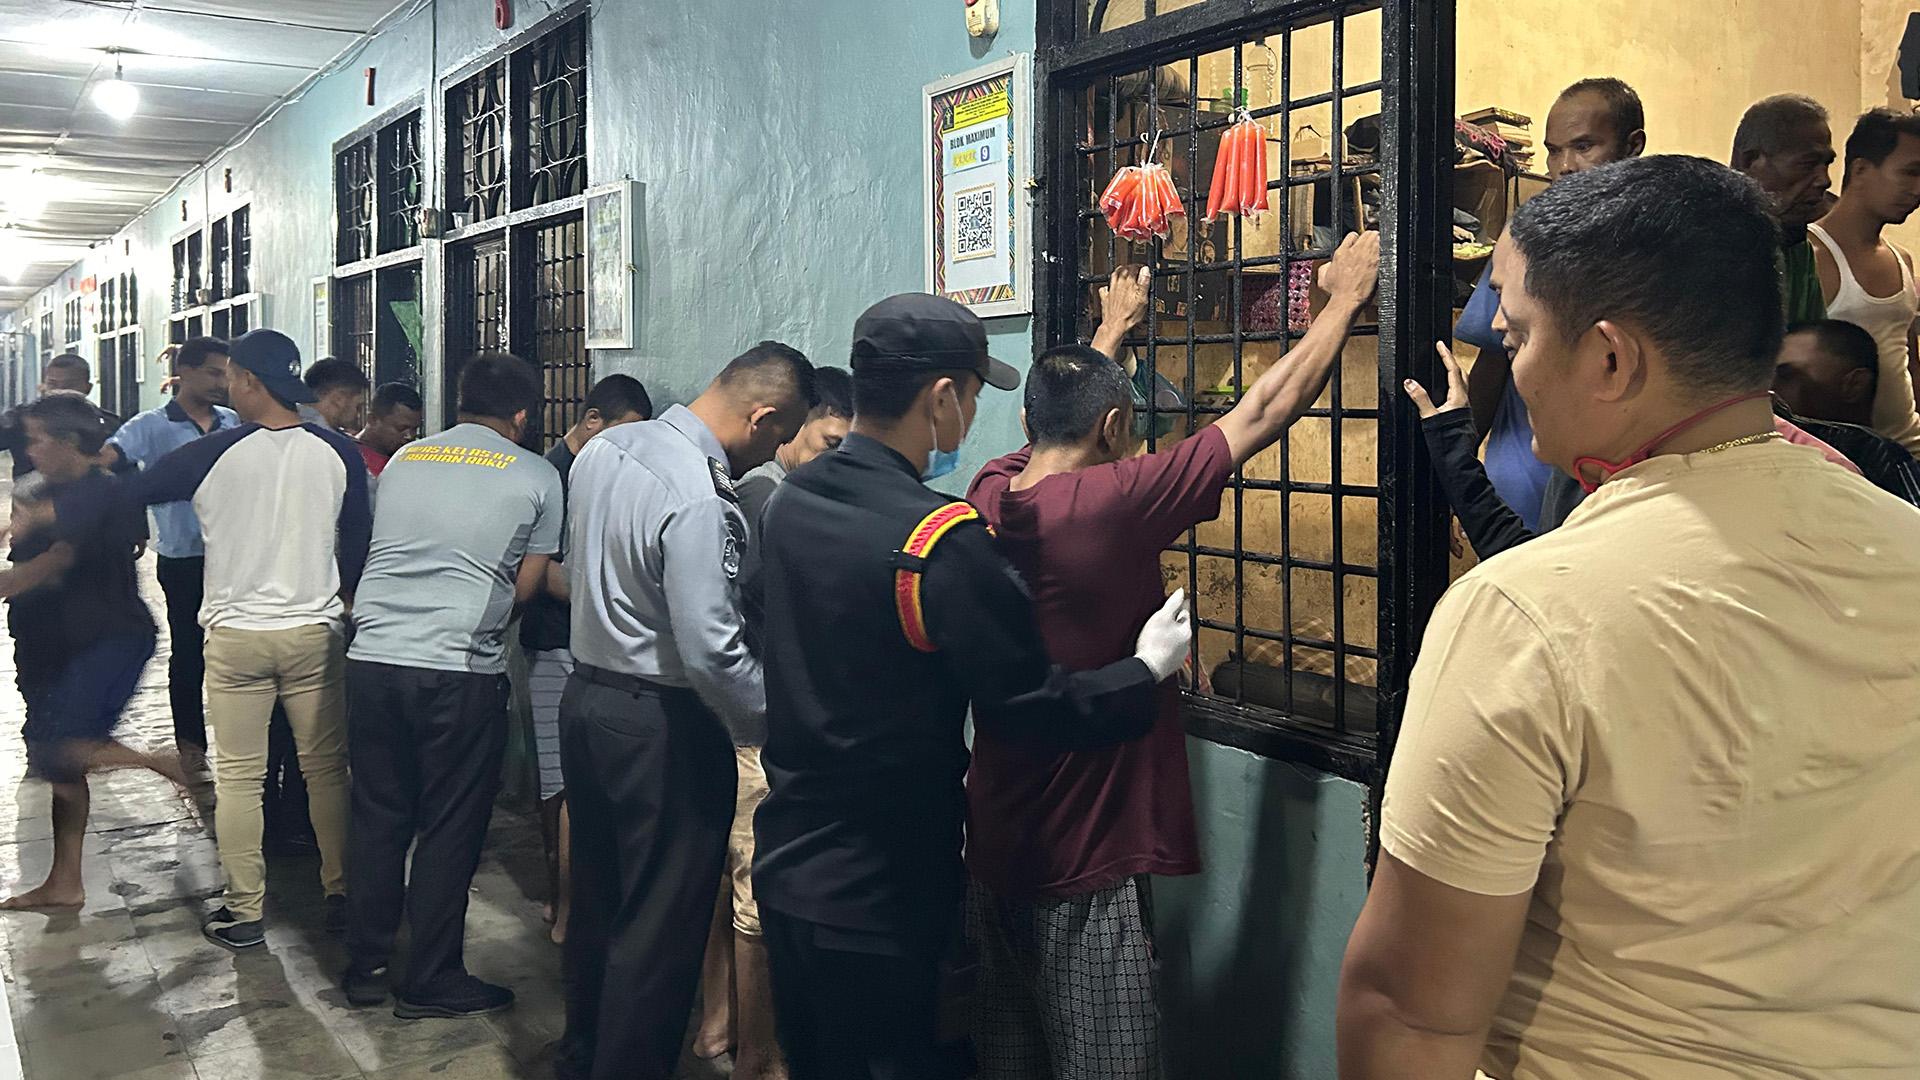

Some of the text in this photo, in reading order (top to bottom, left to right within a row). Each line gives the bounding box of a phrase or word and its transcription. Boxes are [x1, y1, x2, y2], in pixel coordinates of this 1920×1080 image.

[950, 127, 995, 150] BLOK MAXIMUM
[981, 146, 989, 161] 9
